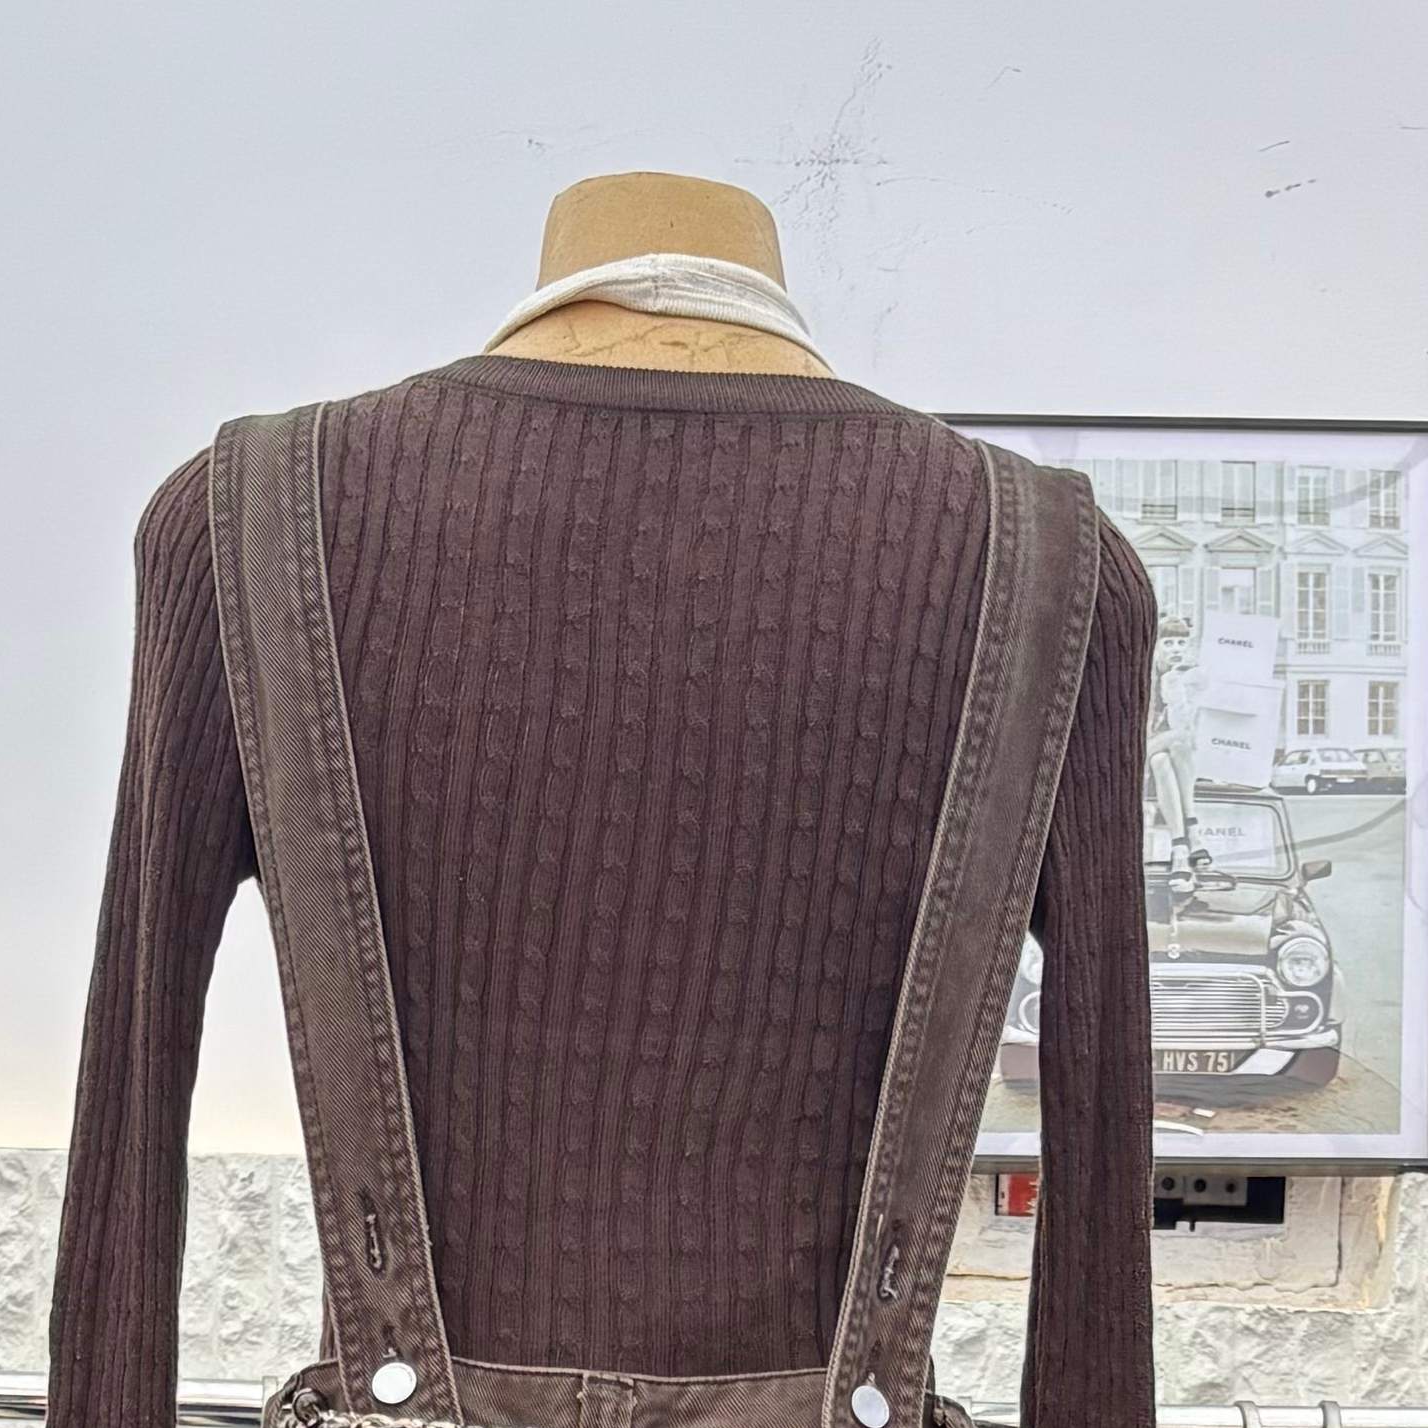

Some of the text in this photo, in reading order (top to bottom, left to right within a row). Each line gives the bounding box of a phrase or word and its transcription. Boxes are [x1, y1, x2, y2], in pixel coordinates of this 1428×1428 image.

[1217, 636, 1254, 649] CHANEL
[1210, 737, 1252, 750] CHANEL
[1163, 1050, 1198, 1072] HVS
